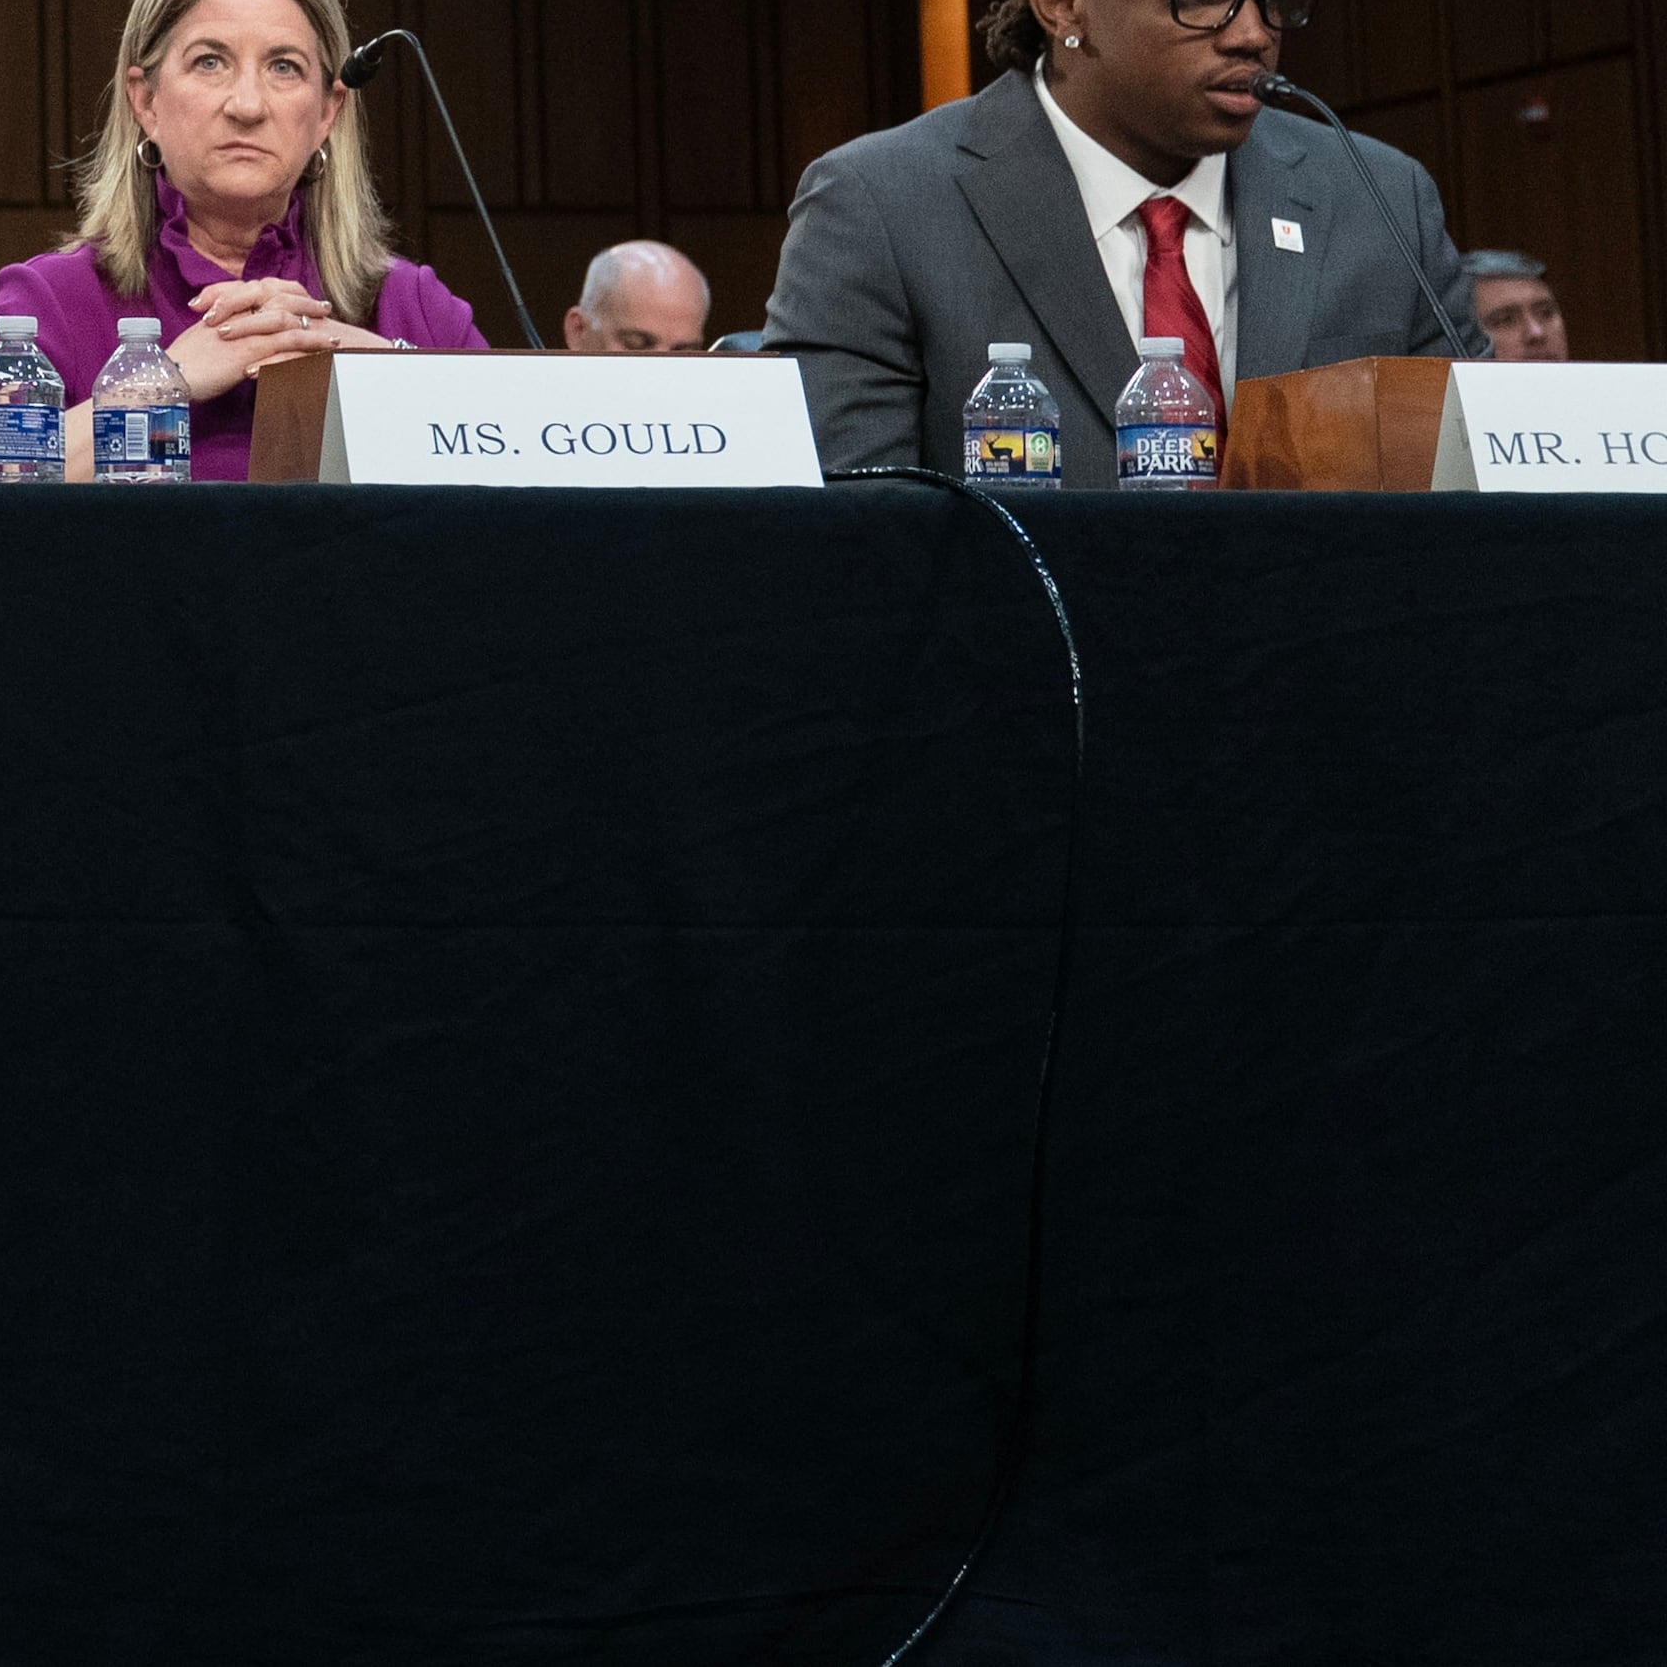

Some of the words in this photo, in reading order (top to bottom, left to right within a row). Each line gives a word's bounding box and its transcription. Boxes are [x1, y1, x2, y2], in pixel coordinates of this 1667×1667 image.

[427, 422, 521, 456] MS.
[540, 422, 727, 456] GOULD
[1136, 437, 1193, 454] DEER
[1483, 431, 1582, 466] MR.
[1137, 454, 1195, 476] PARK
